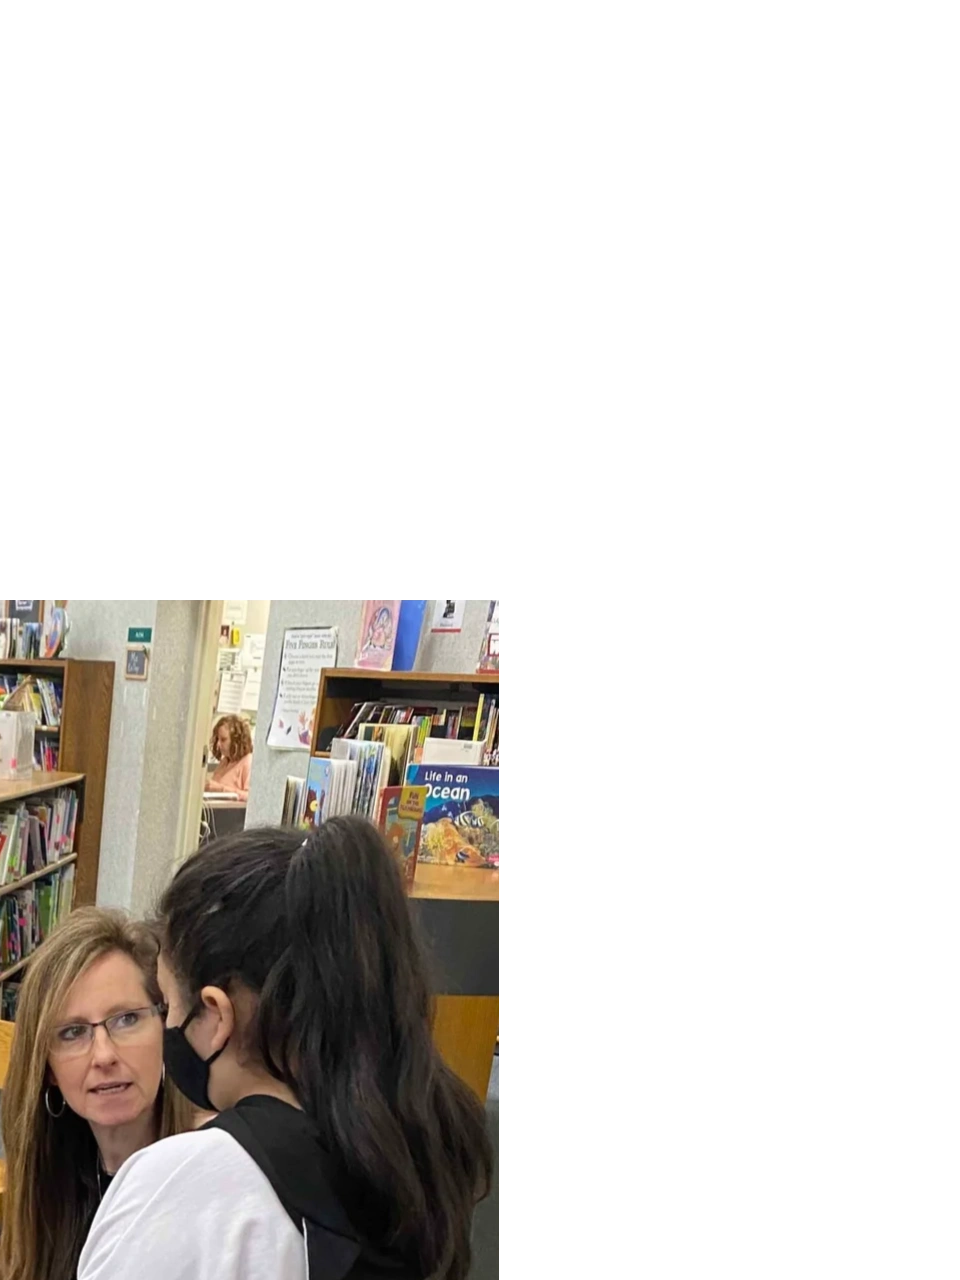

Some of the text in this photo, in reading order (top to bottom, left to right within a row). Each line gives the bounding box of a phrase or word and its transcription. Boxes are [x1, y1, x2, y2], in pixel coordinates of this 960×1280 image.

[424, 770, 468, 783] Life in an
